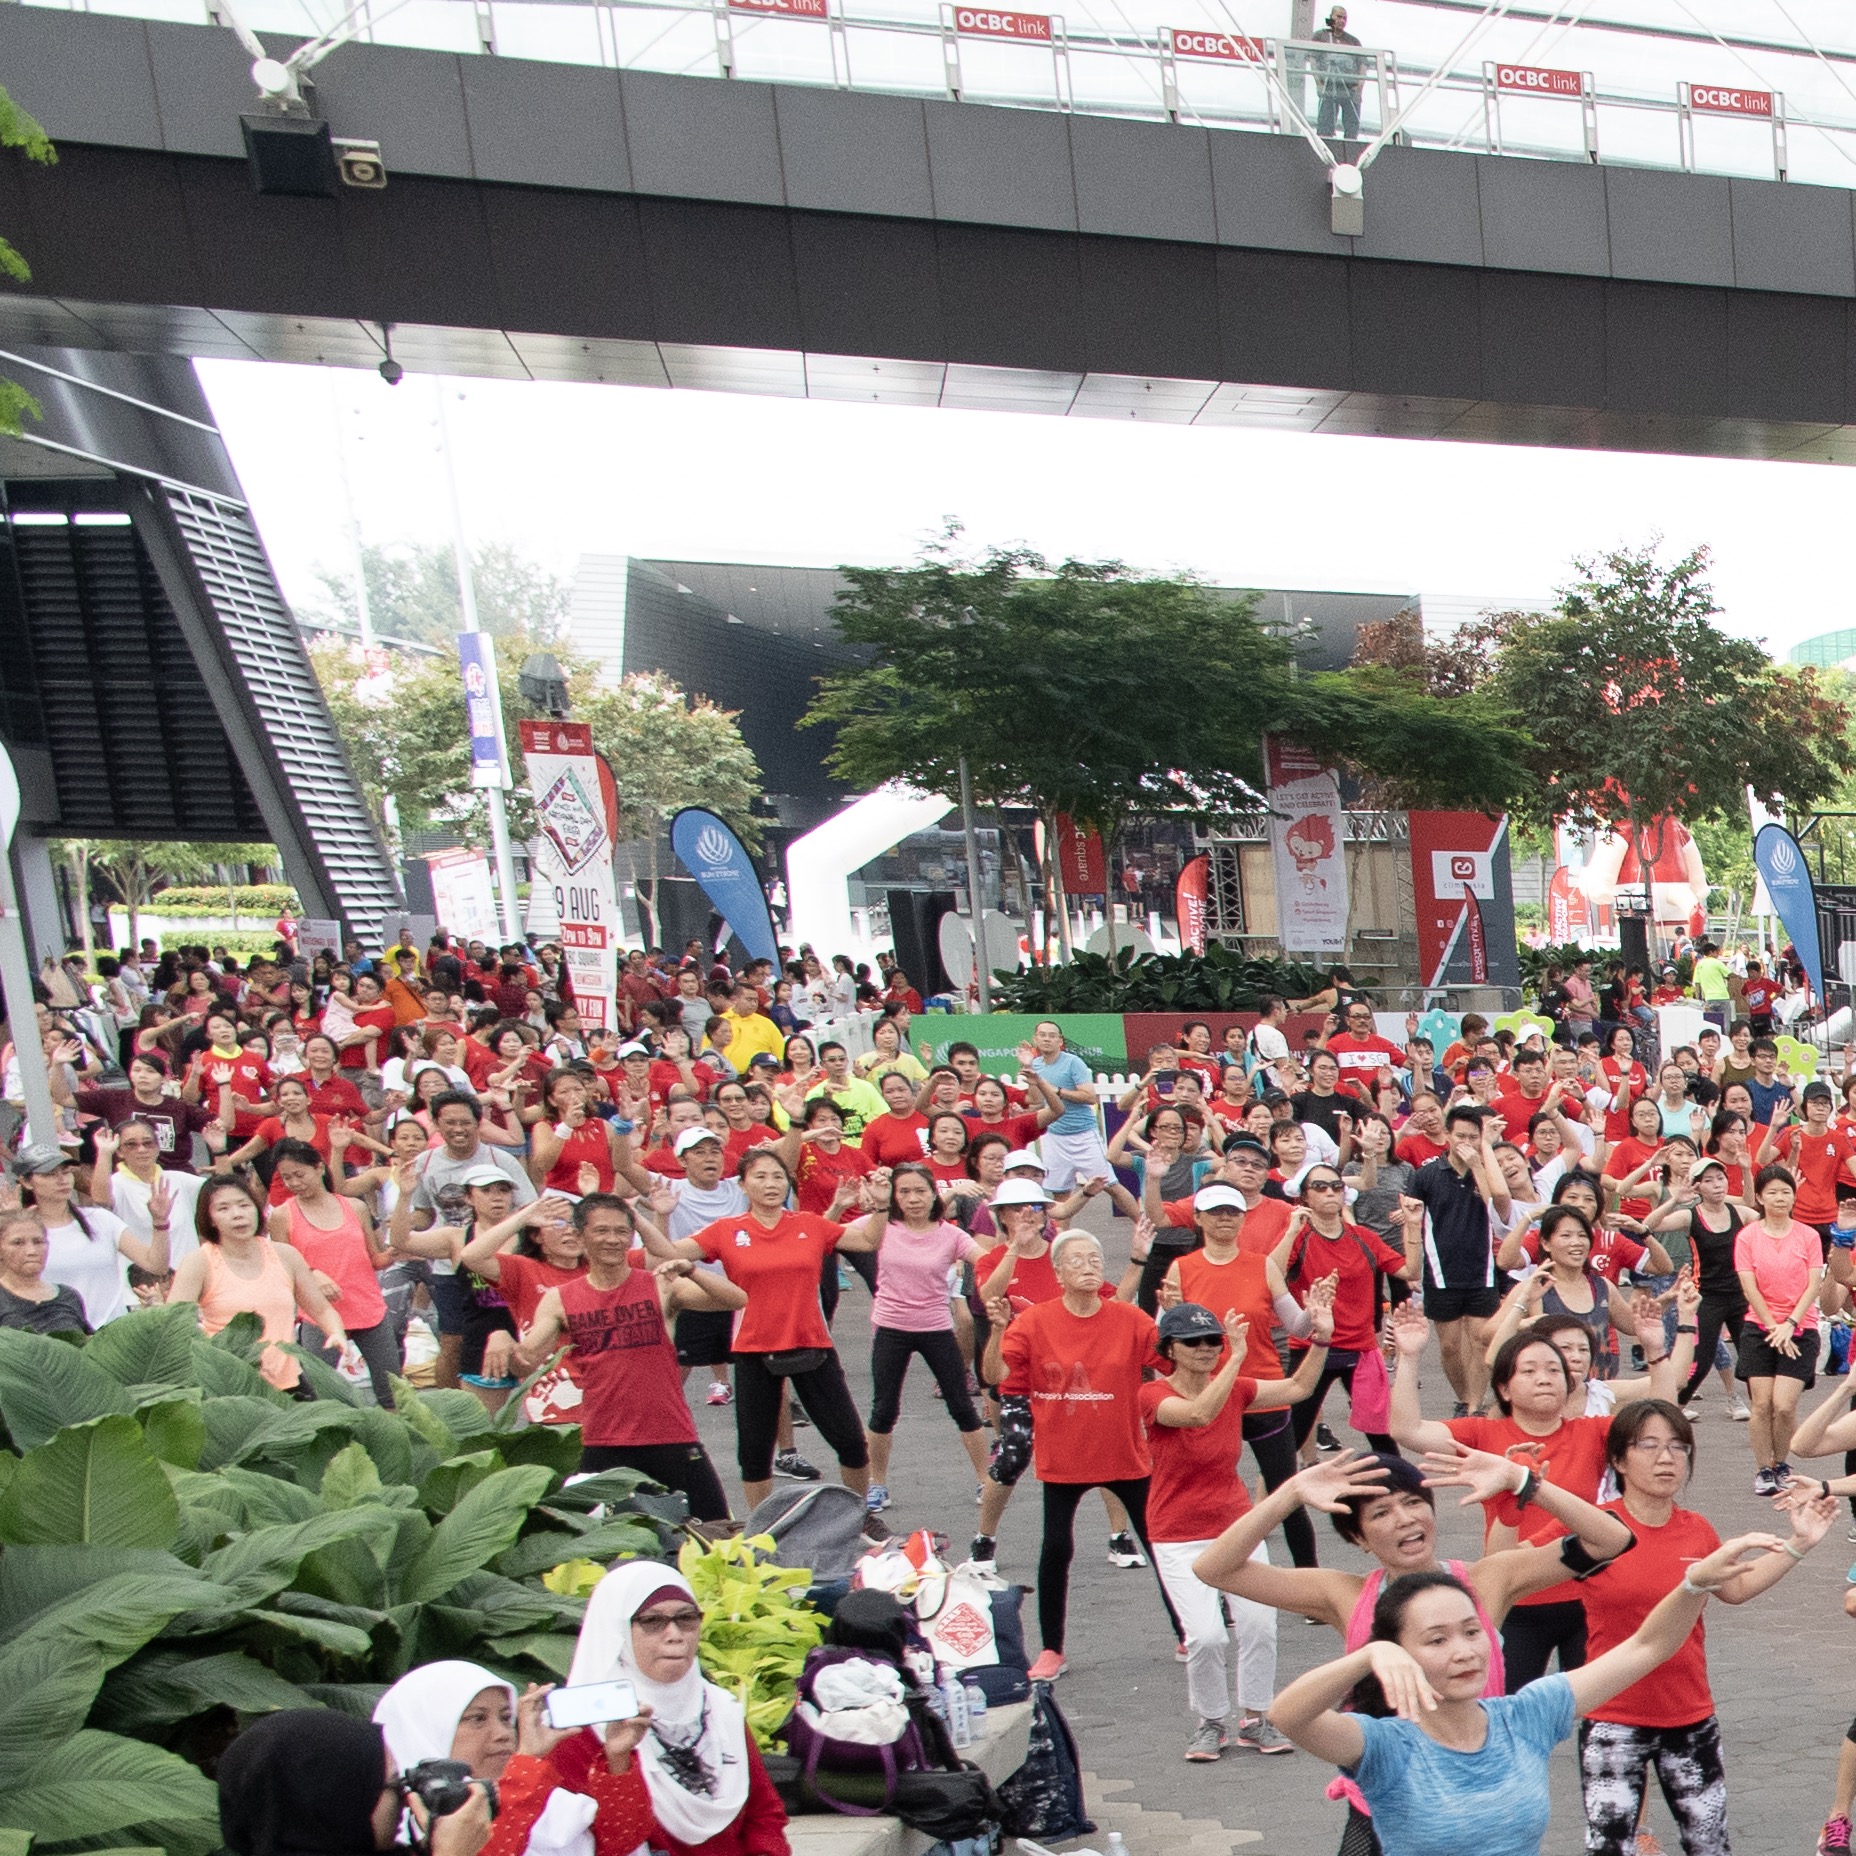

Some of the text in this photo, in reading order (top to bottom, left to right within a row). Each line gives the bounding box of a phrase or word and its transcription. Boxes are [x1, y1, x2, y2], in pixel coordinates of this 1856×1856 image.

[957, 12, 1046, 36] OCBC link
[1176, 32, 1230, 54] OCBC
[1499, 69, 1577, 93] OCBC link
[1693, 89, 1769, 112] OCBC link
[1075, 841, 1089, 882] square
[555, 886, 600, 922] 9 AUG
[1183, 891, 1200, 952] ACTIVE!
[613, 1299, 656, 1324] OVER
[1073, 1389, 1124, 1401] Association
